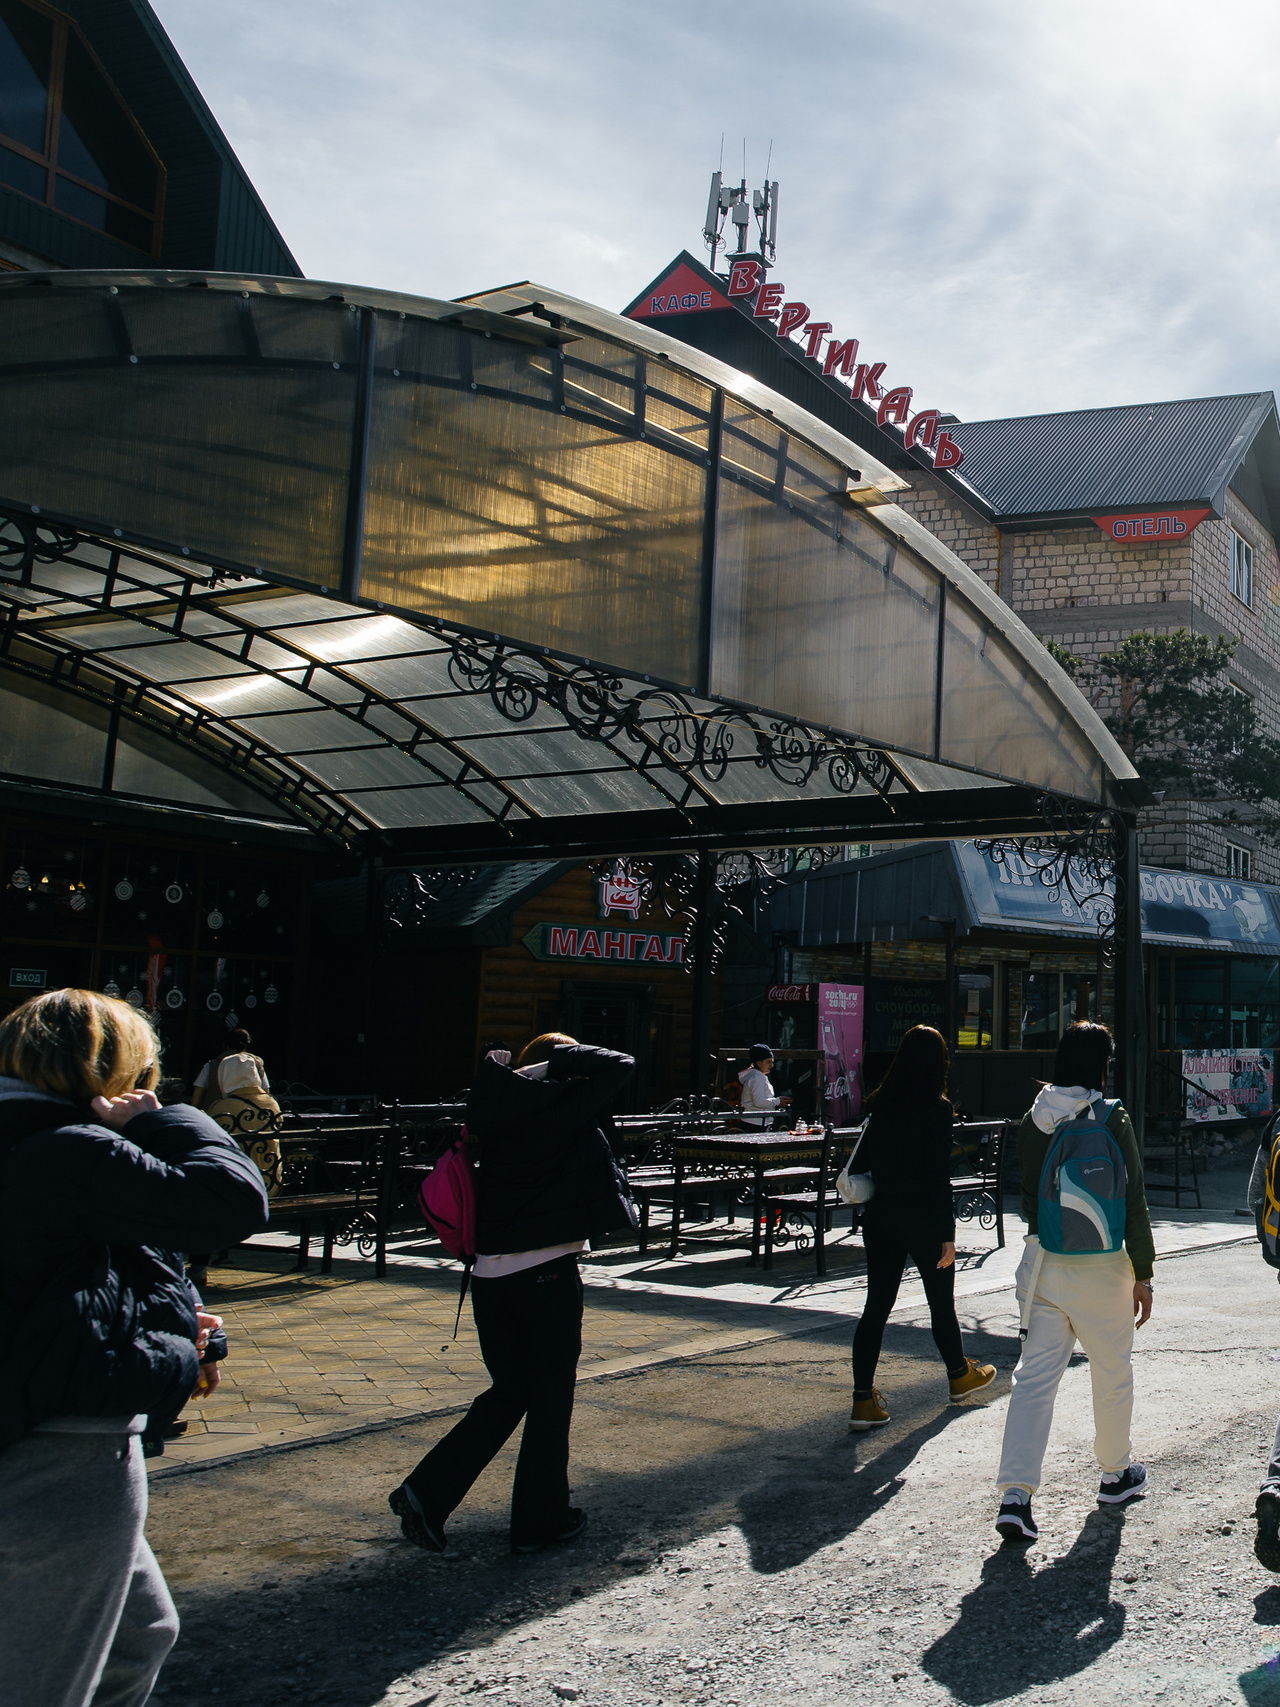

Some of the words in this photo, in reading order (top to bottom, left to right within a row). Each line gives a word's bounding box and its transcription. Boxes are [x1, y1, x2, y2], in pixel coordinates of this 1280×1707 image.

[651, 291, 712, 314] КАФЕ
[728, 260, 964, 469] ВЕРТИКАЛЬ
[1112, 516, 1187, 538] ОТЕЛЬ
[549, 927, 686, 963] МАНГАЛ
[16, 973, 41, 984] ВХОД
[825, 990, 858, 1001] sochi.ru
